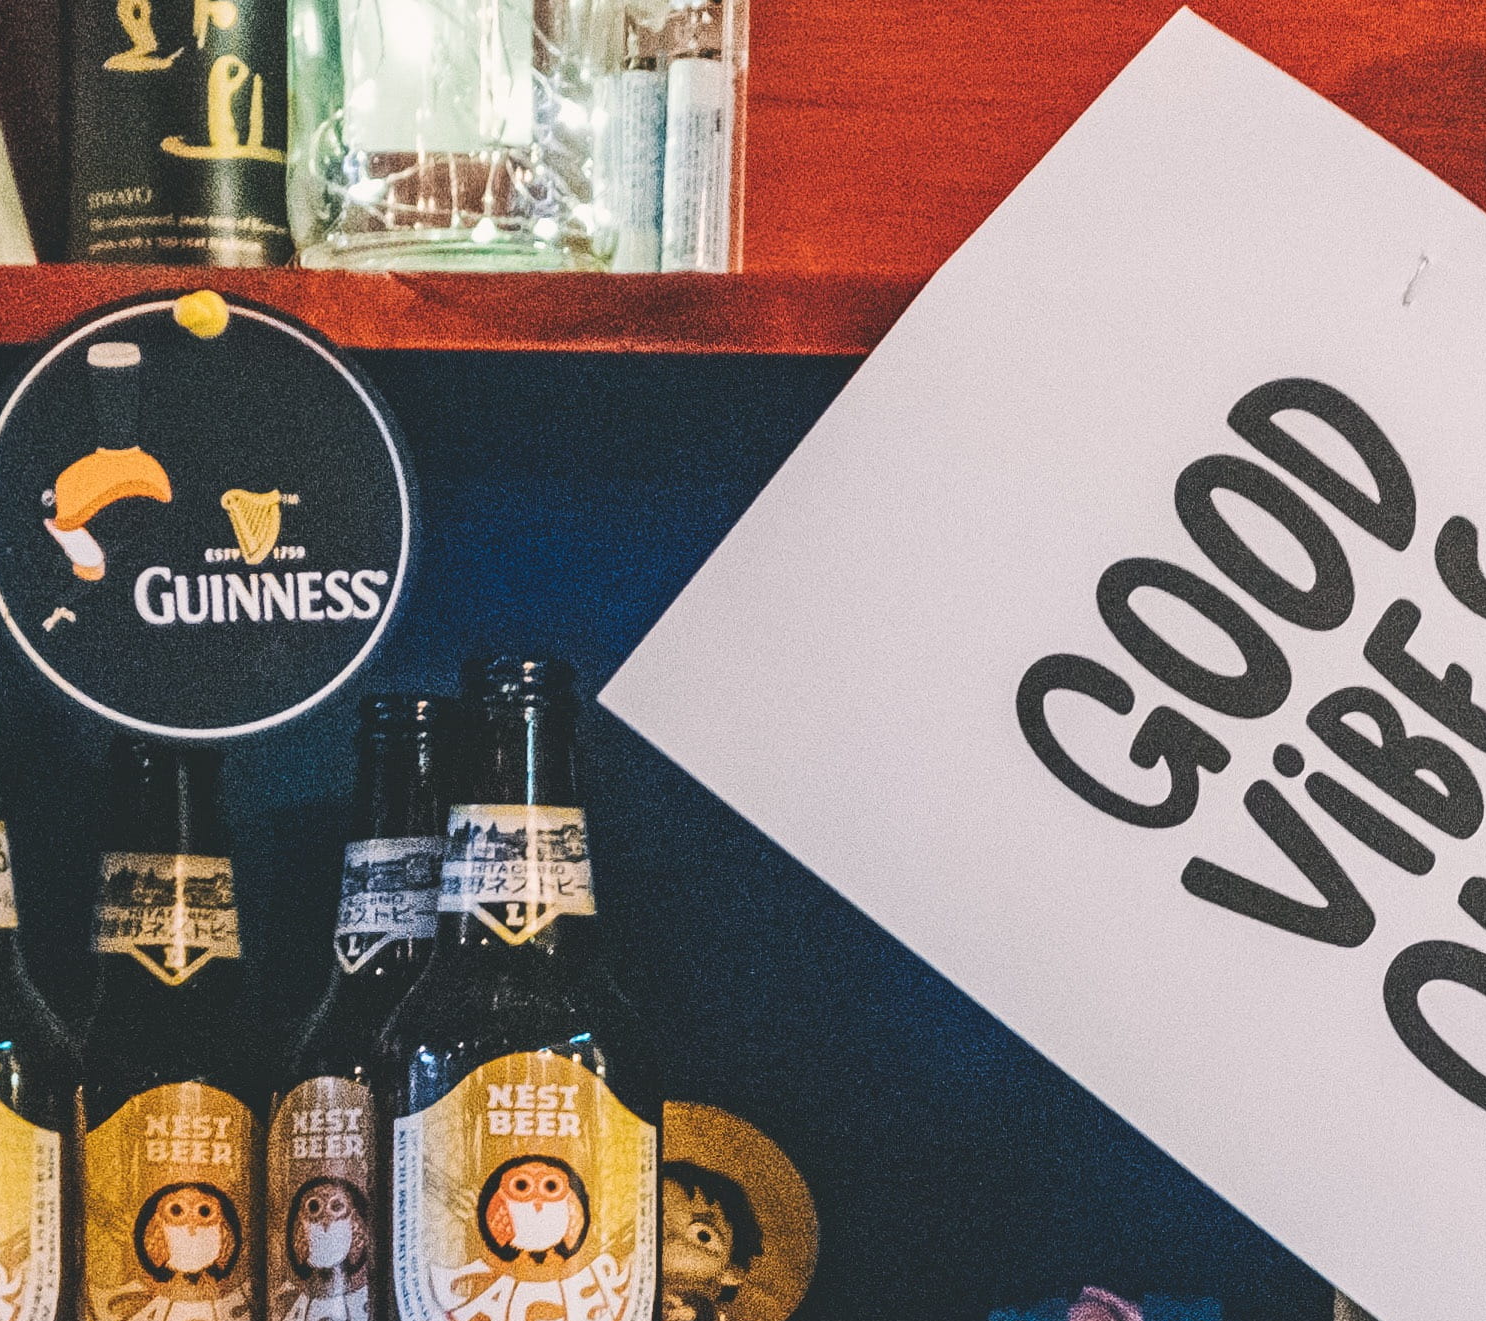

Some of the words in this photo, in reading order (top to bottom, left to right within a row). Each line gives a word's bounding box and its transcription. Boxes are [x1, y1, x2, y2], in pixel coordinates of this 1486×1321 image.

[134, 566, 382, 624] GUINNESS
[1016, 377, 1417, 830] GOOD
[486, 1083, 580, 1111] NEST
[147, 1113, 233, 1141] NEST
[292, 1107, 363, 1136] NEST
[487, 1111, 583, 1138] BEER
[147, 1142, 234, 1167] BEER
[293, 1136, 364, 1160] BEER
